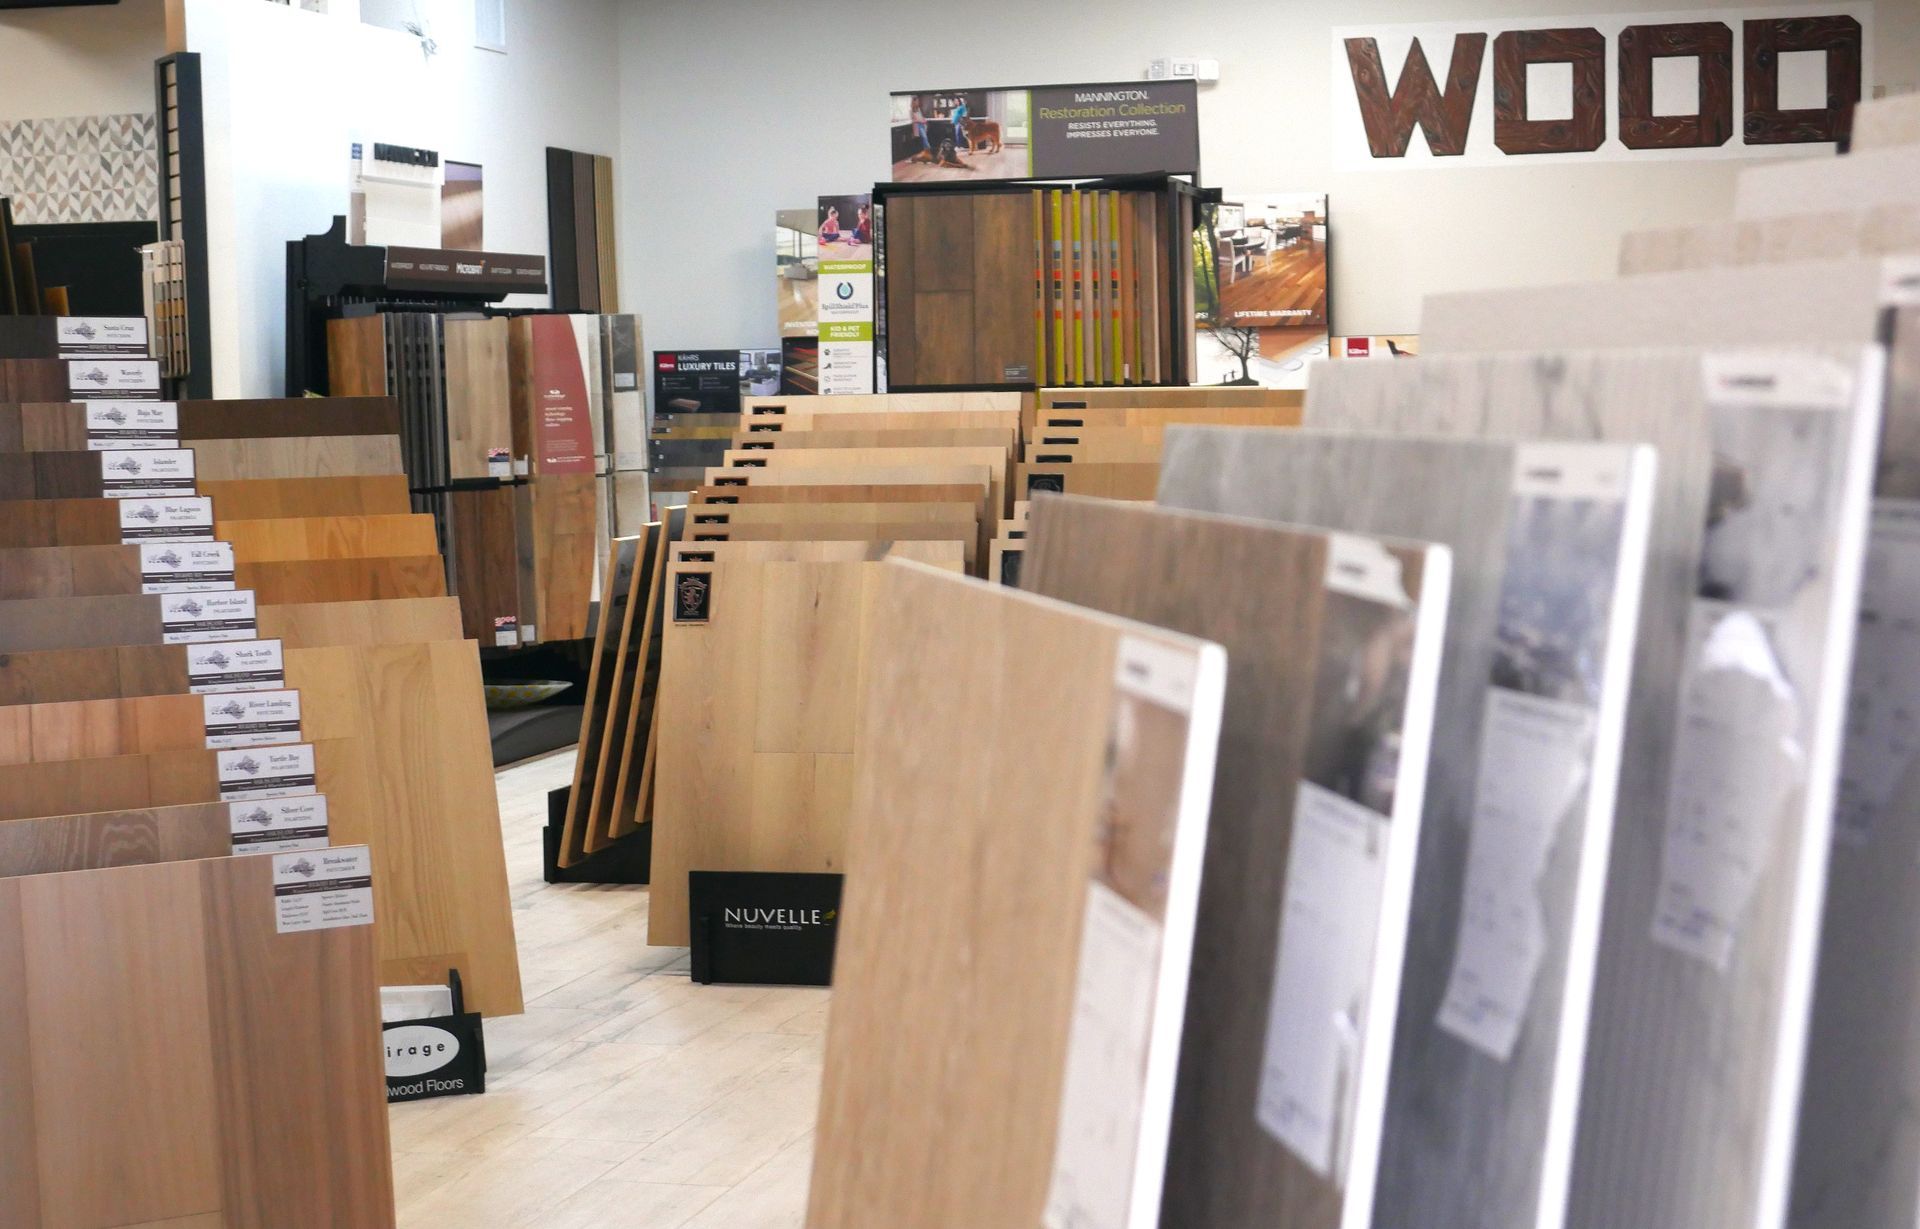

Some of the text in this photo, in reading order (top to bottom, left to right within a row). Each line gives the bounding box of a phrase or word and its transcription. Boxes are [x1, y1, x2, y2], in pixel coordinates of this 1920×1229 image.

[1344, 15, 1862, 158] WOOD
[1040, 102, 1186, 119] Restoration Collection
[1068, 121, 1101, 130] RESISTS
[1067, 130, 1111, 139] IMPRESSES
[1269, 309, 1312, 317] WARRANTY
[678, 362, 712, 371] LUXURY
[713, 362, 736, 371] TILES
[323, 855, 358, 865] Breakwater
[724, 907, 821, 925] NUVELLE
[387, 1043, 445, 1058] irage
[426, 1078, 464, 1092] Floors
